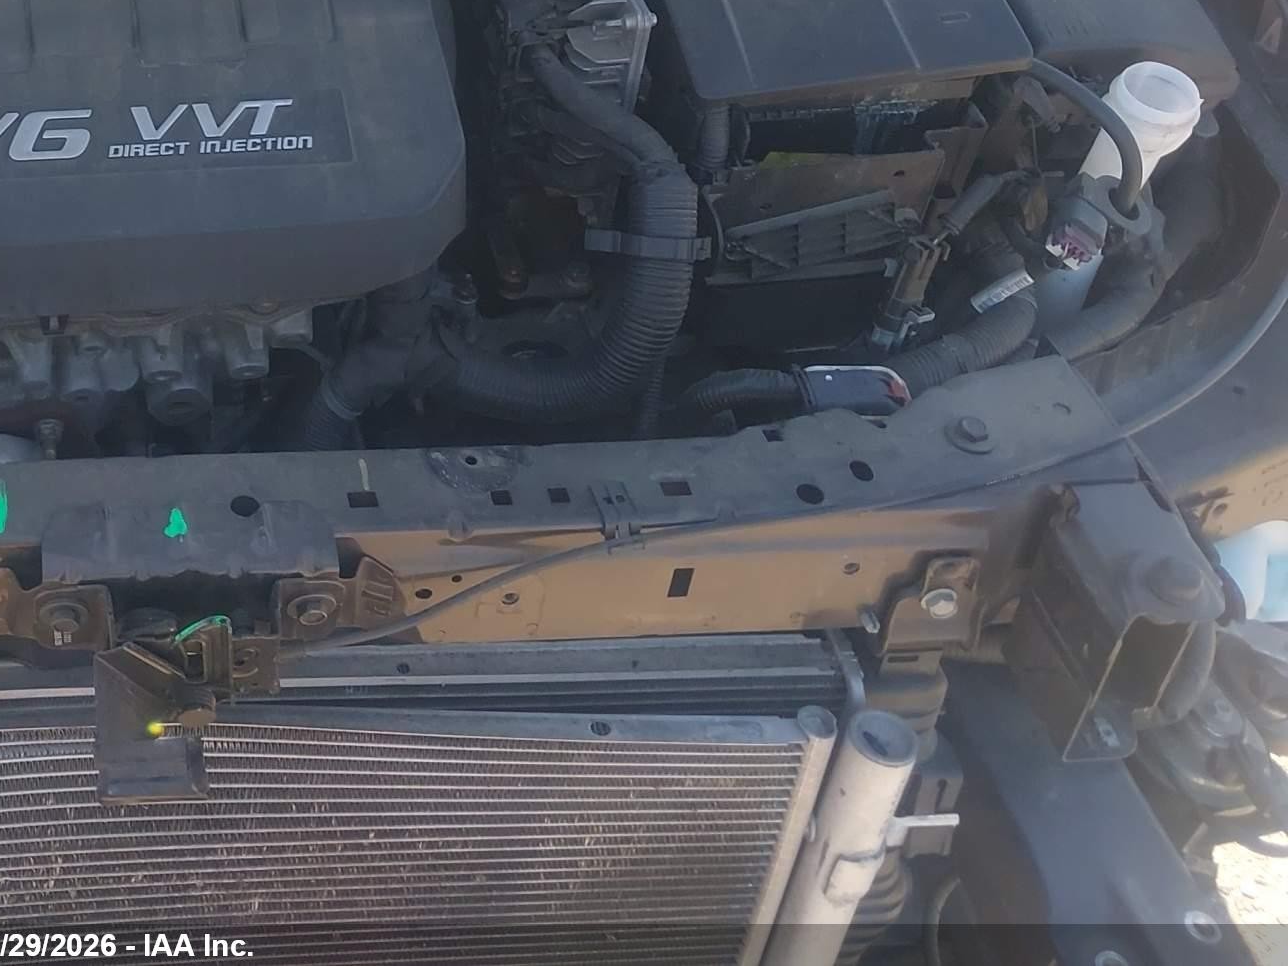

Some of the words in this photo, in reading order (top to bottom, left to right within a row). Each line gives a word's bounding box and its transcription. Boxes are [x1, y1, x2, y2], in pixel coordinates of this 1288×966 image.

[130, 99, 293, 140] VVT
[108, 142, 190, 158] DIRECT
[199, 136, 313, 155] INJECTION
